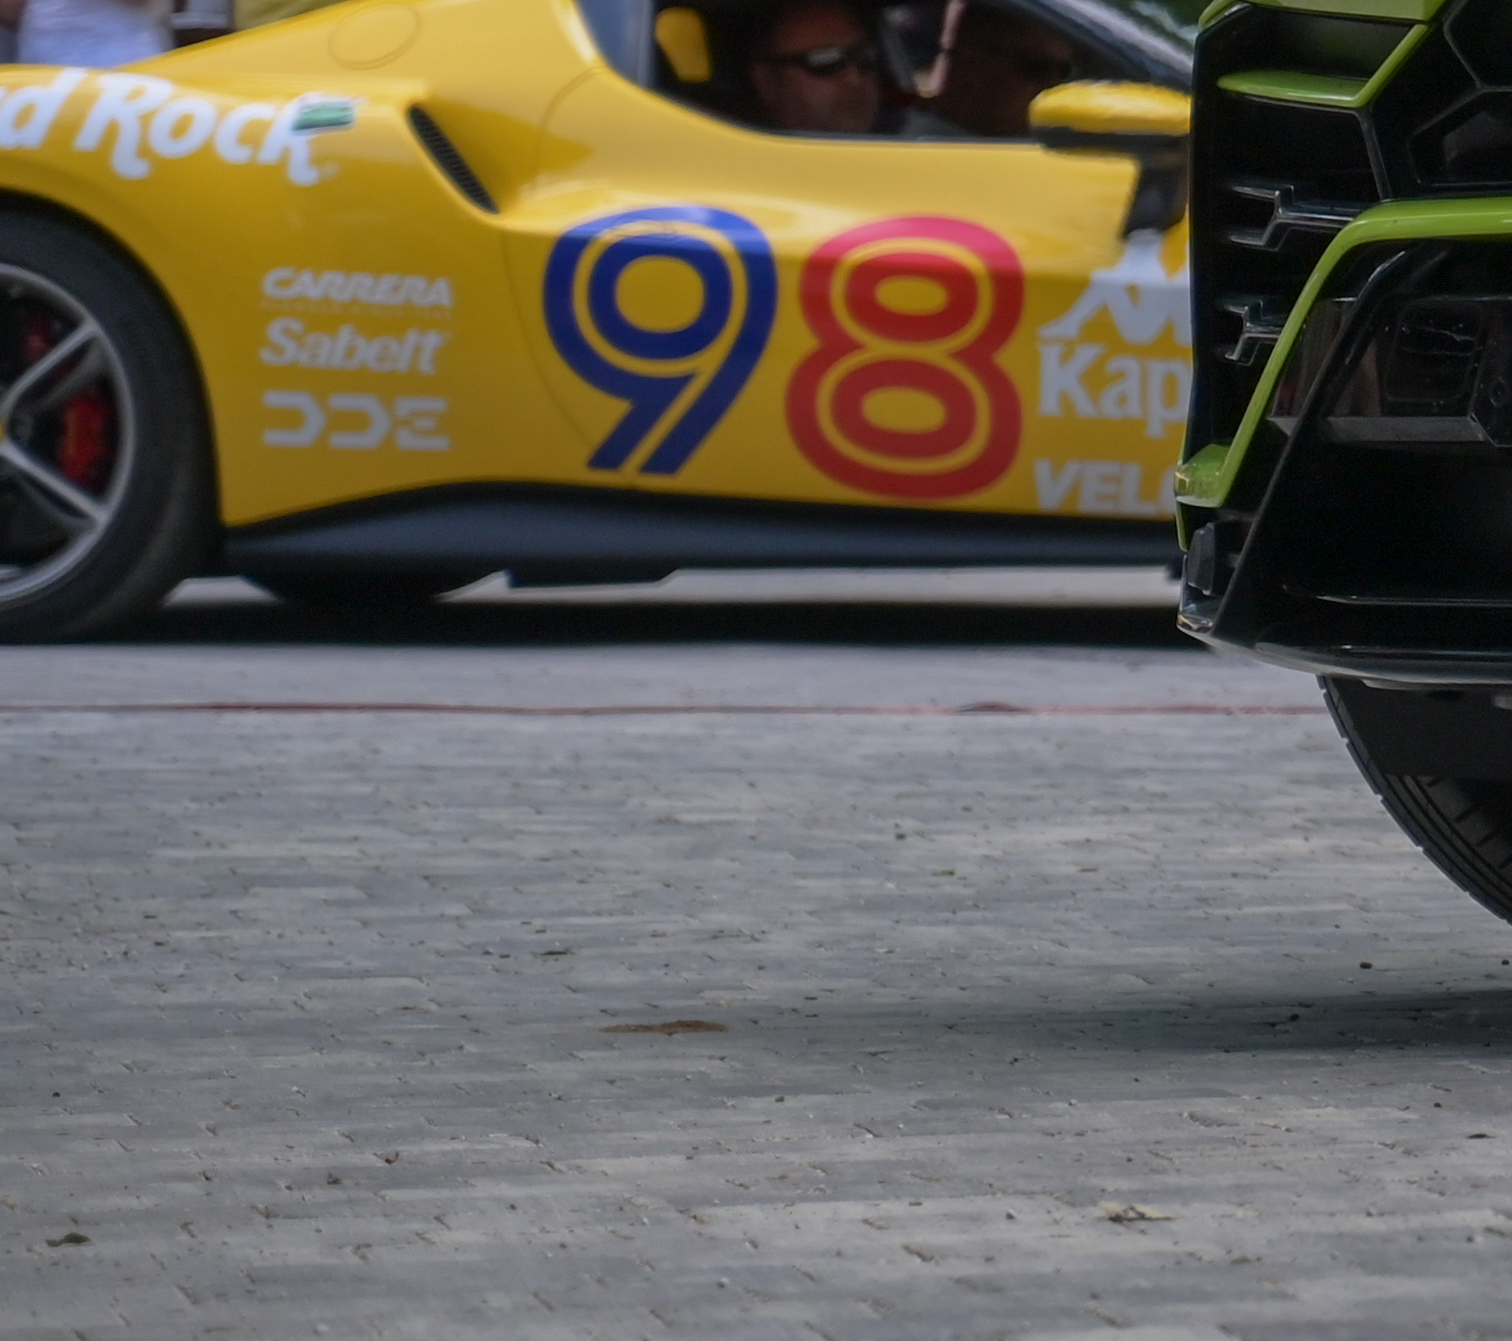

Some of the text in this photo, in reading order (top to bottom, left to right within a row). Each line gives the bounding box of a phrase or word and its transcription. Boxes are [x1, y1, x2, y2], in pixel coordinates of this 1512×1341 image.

[262, 266, 455, 307] CARRERA
[260, 316, 446, 375] Sabelt
[543, 204, 1024, 503] 98
[264, 390, 452, 451] DDE
